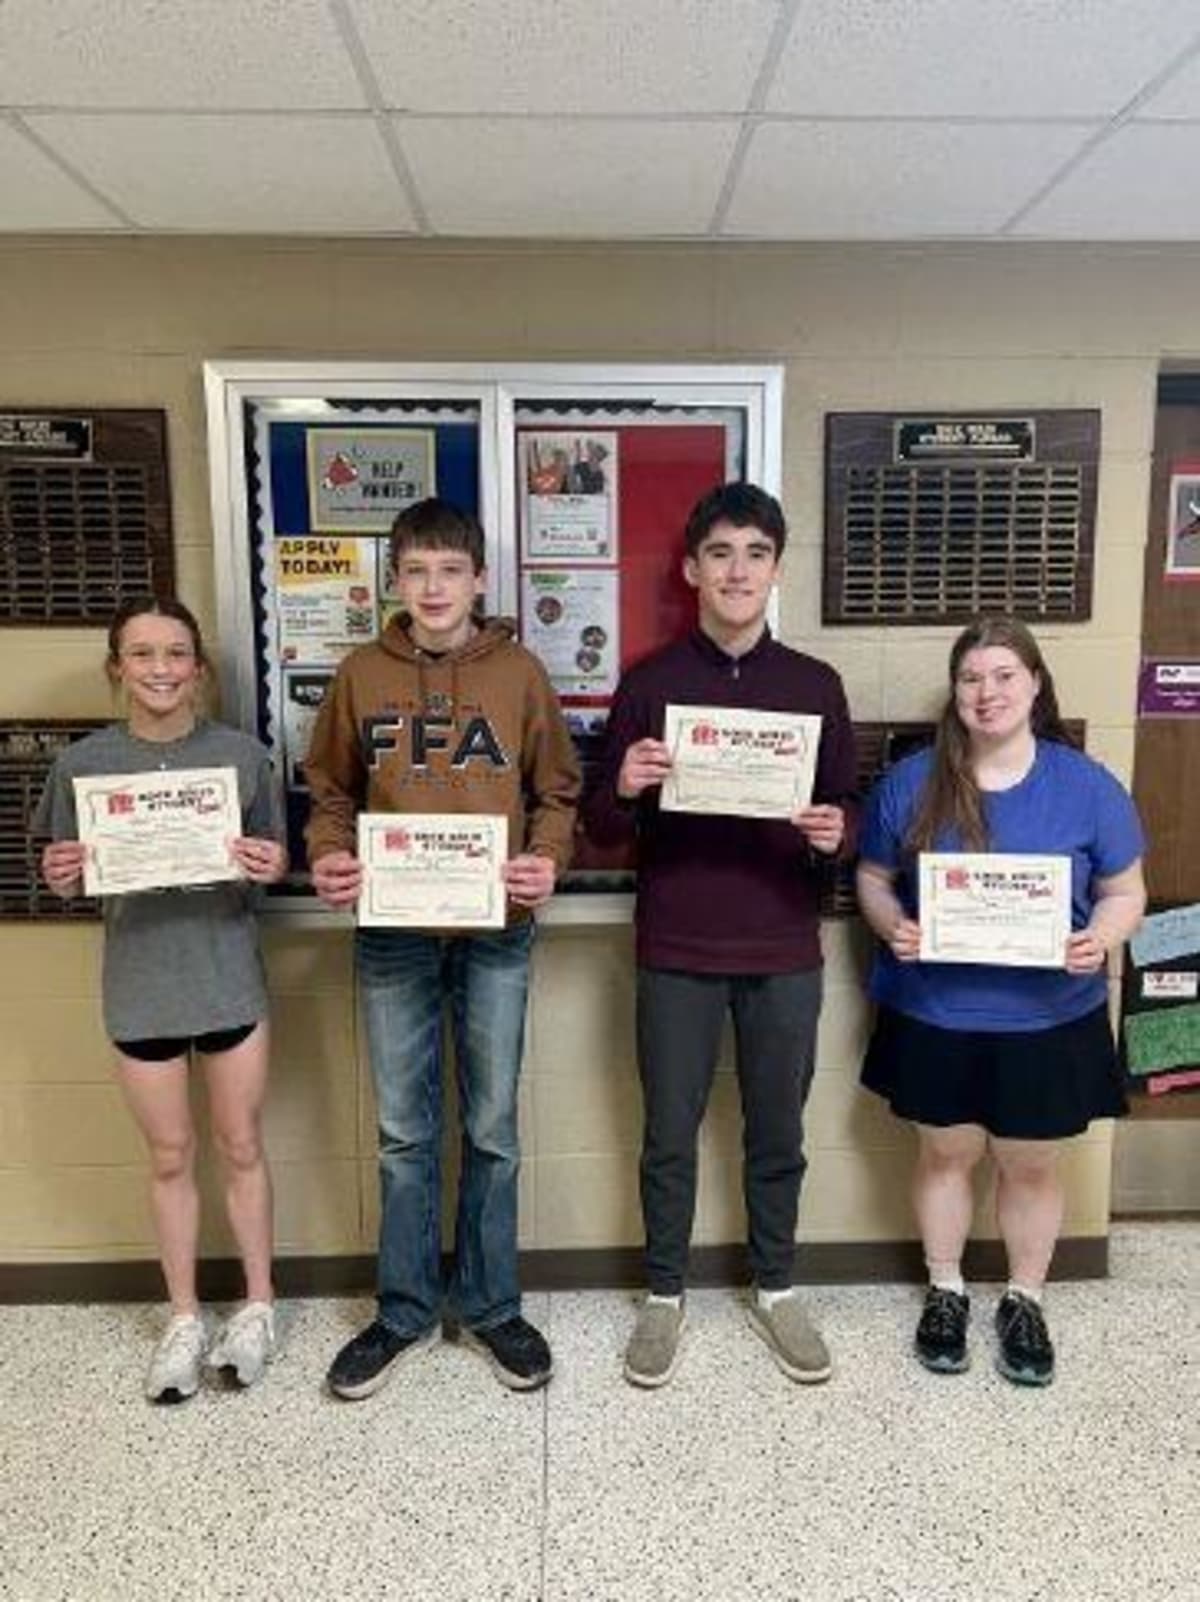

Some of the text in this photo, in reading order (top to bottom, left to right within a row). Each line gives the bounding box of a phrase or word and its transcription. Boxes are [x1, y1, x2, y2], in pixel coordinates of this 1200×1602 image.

[371, 461, 404, 478] HELP
[280, 541, 341, 554] APPLY
[280, 559, 351, 574] TODAY!
[362, 716, 512, 768] FFA
